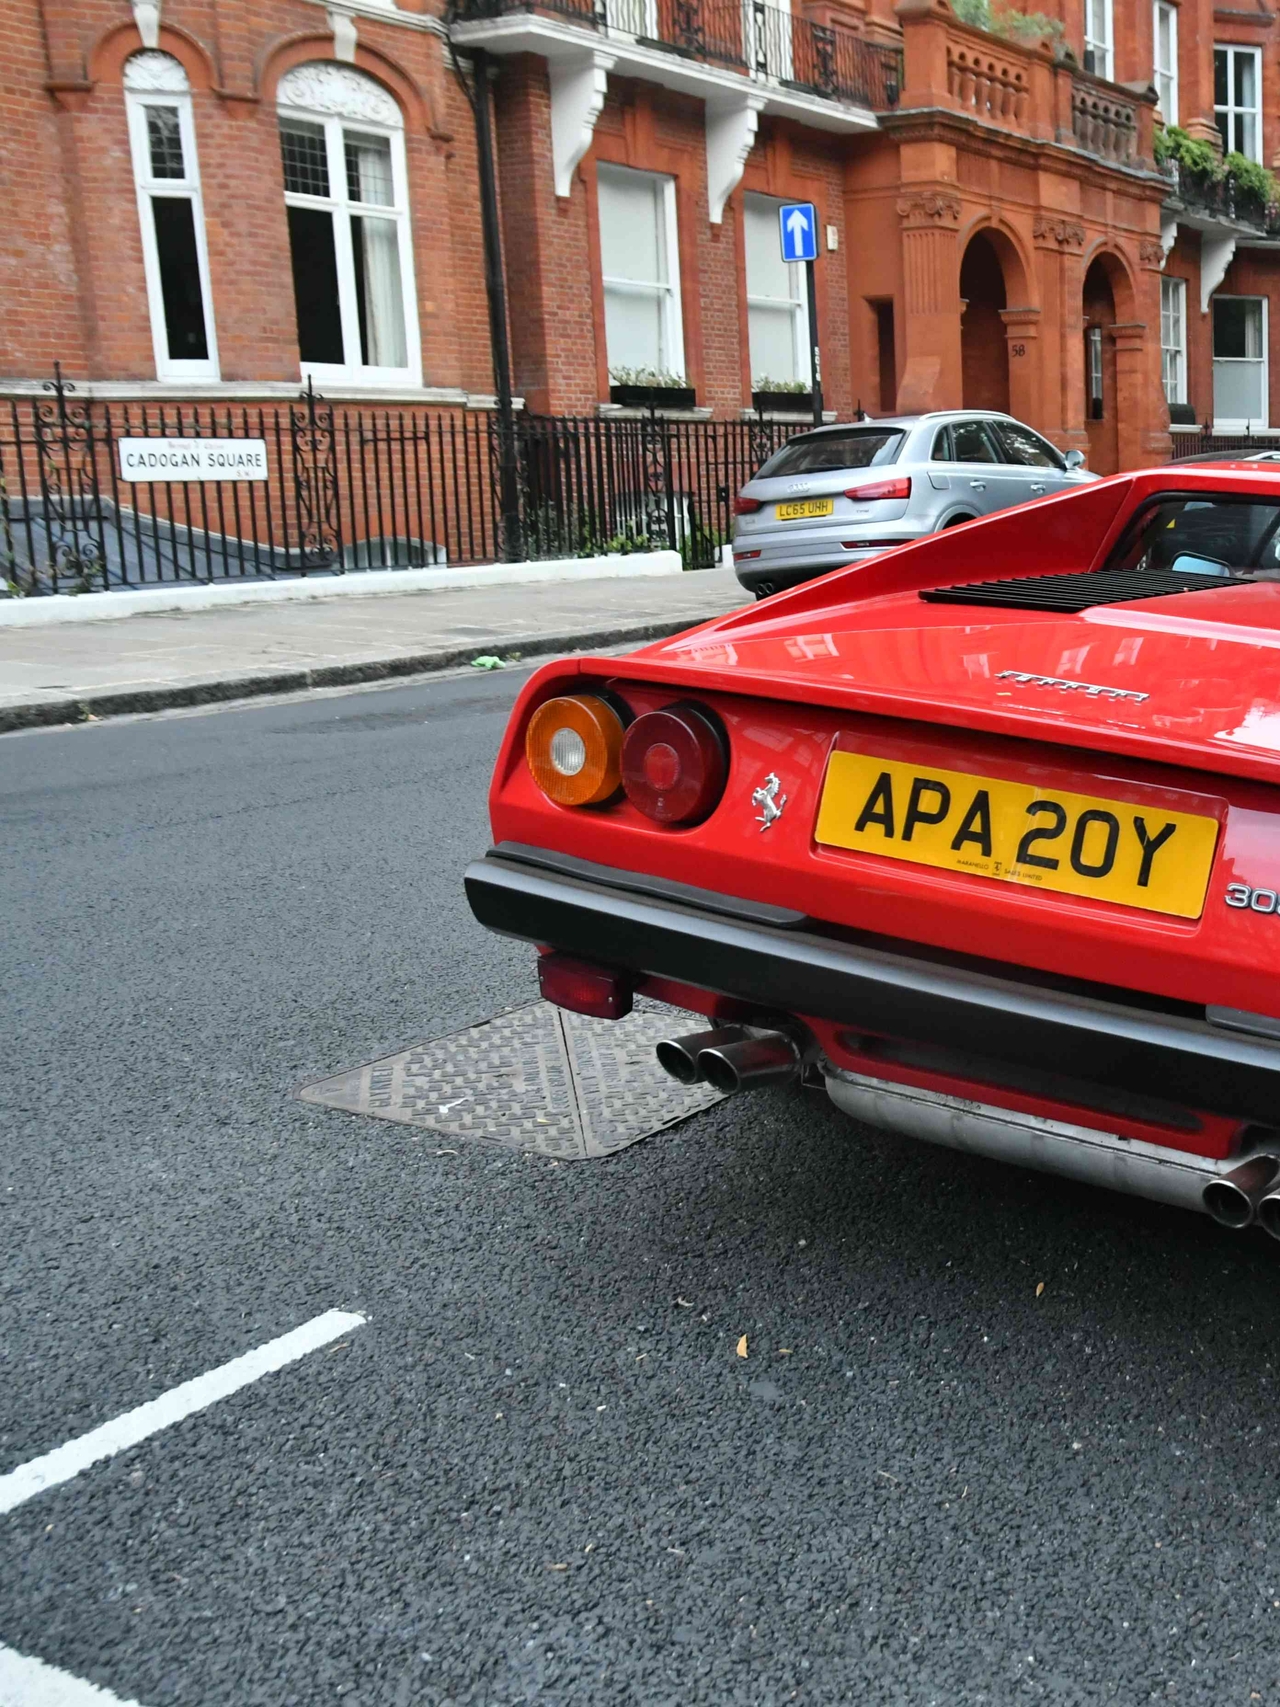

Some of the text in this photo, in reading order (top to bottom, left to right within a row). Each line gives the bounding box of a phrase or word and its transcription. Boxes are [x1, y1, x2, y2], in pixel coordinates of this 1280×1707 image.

[1011, 344, 1026, 357] 58
[126, 453, 263, 468] CADOGAN SQUARE
[779, 503, 806, 517] LC65
[854, 772, 1178, 888] APA 20Y
